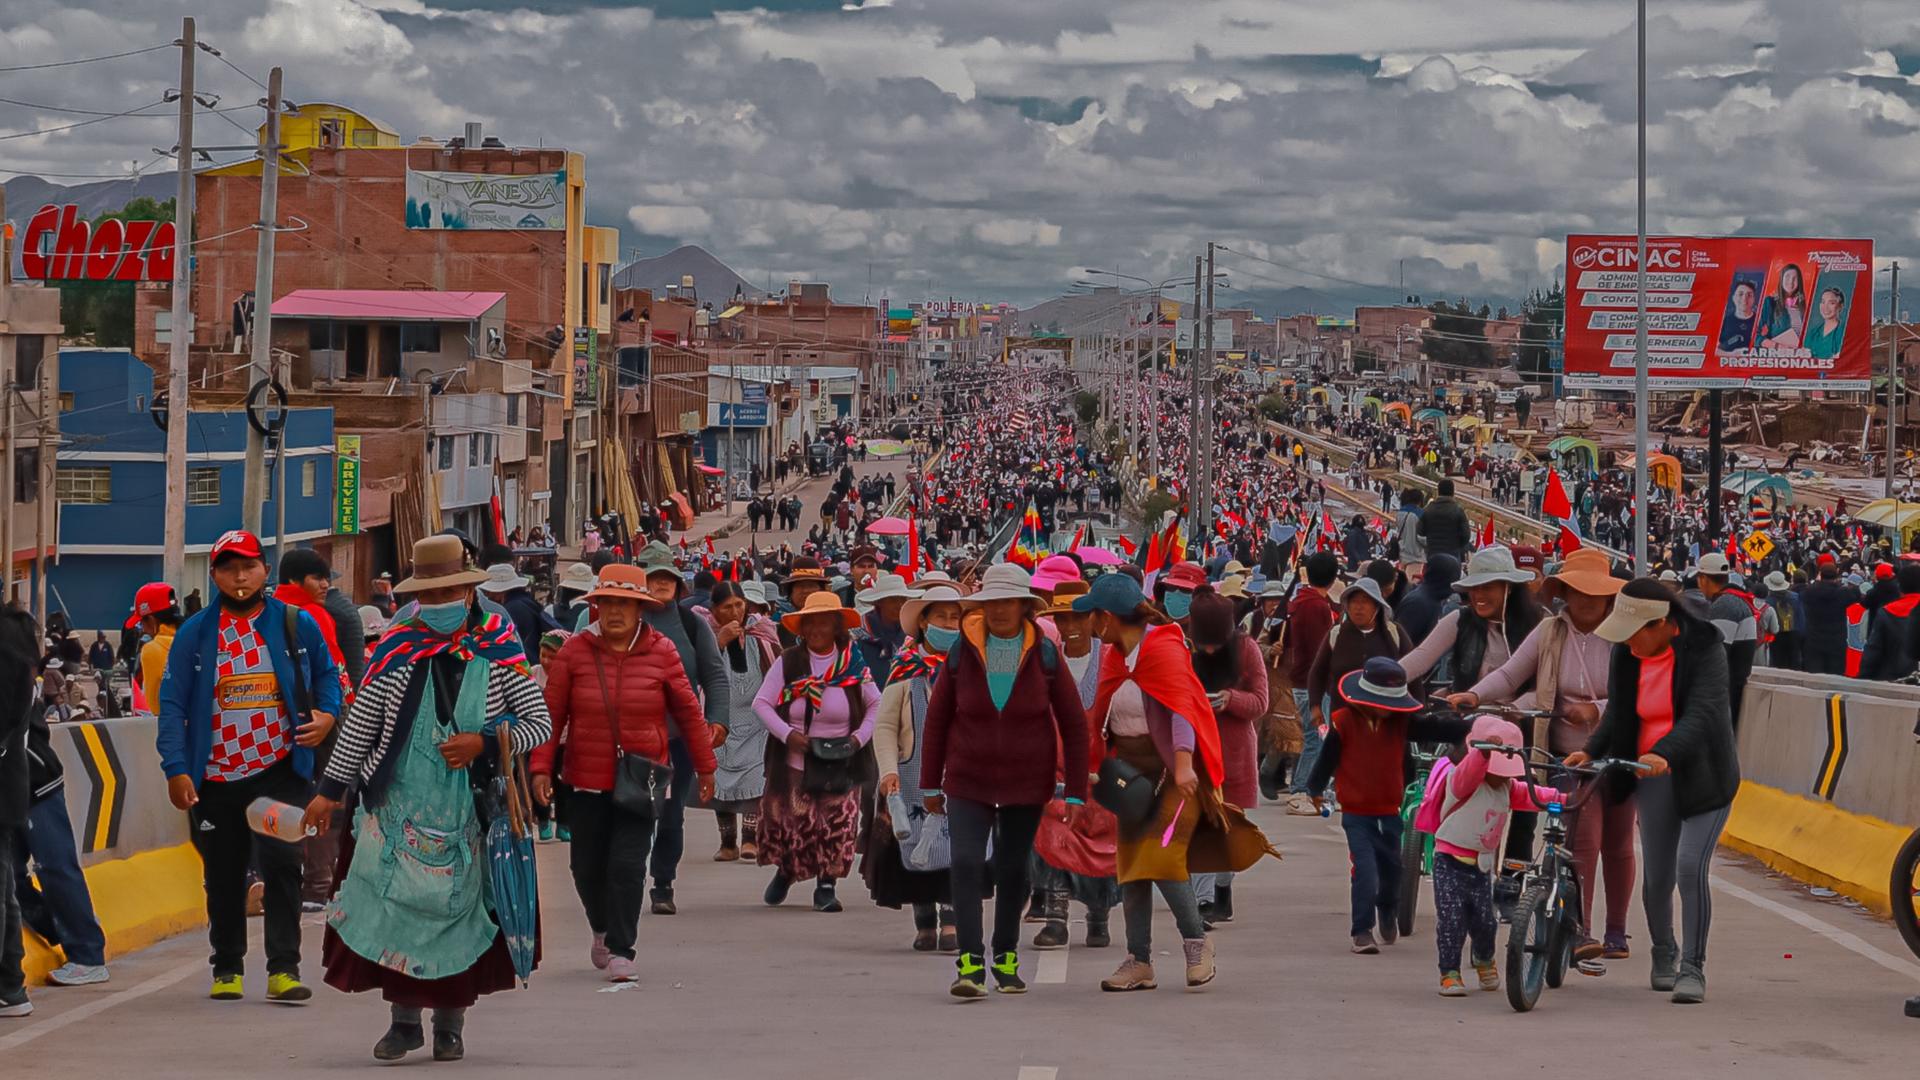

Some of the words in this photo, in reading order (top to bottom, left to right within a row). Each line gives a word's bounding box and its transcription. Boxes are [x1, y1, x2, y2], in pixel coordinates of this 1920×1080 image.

[1614, 281, 1671, 290] EMPESAS
[1601, 295, 1681, 304] CONTALIDAD
[1609, 314, 1687, 322] COMPTACIÓN
[1625, 337, 1698, 347] EERMERÍA
[1631, 356, 1690, 365] FRMACIA
[1719, 357, 1835, 369] PROFESIONALES
[342, 461, 355, 533] BREVETES
